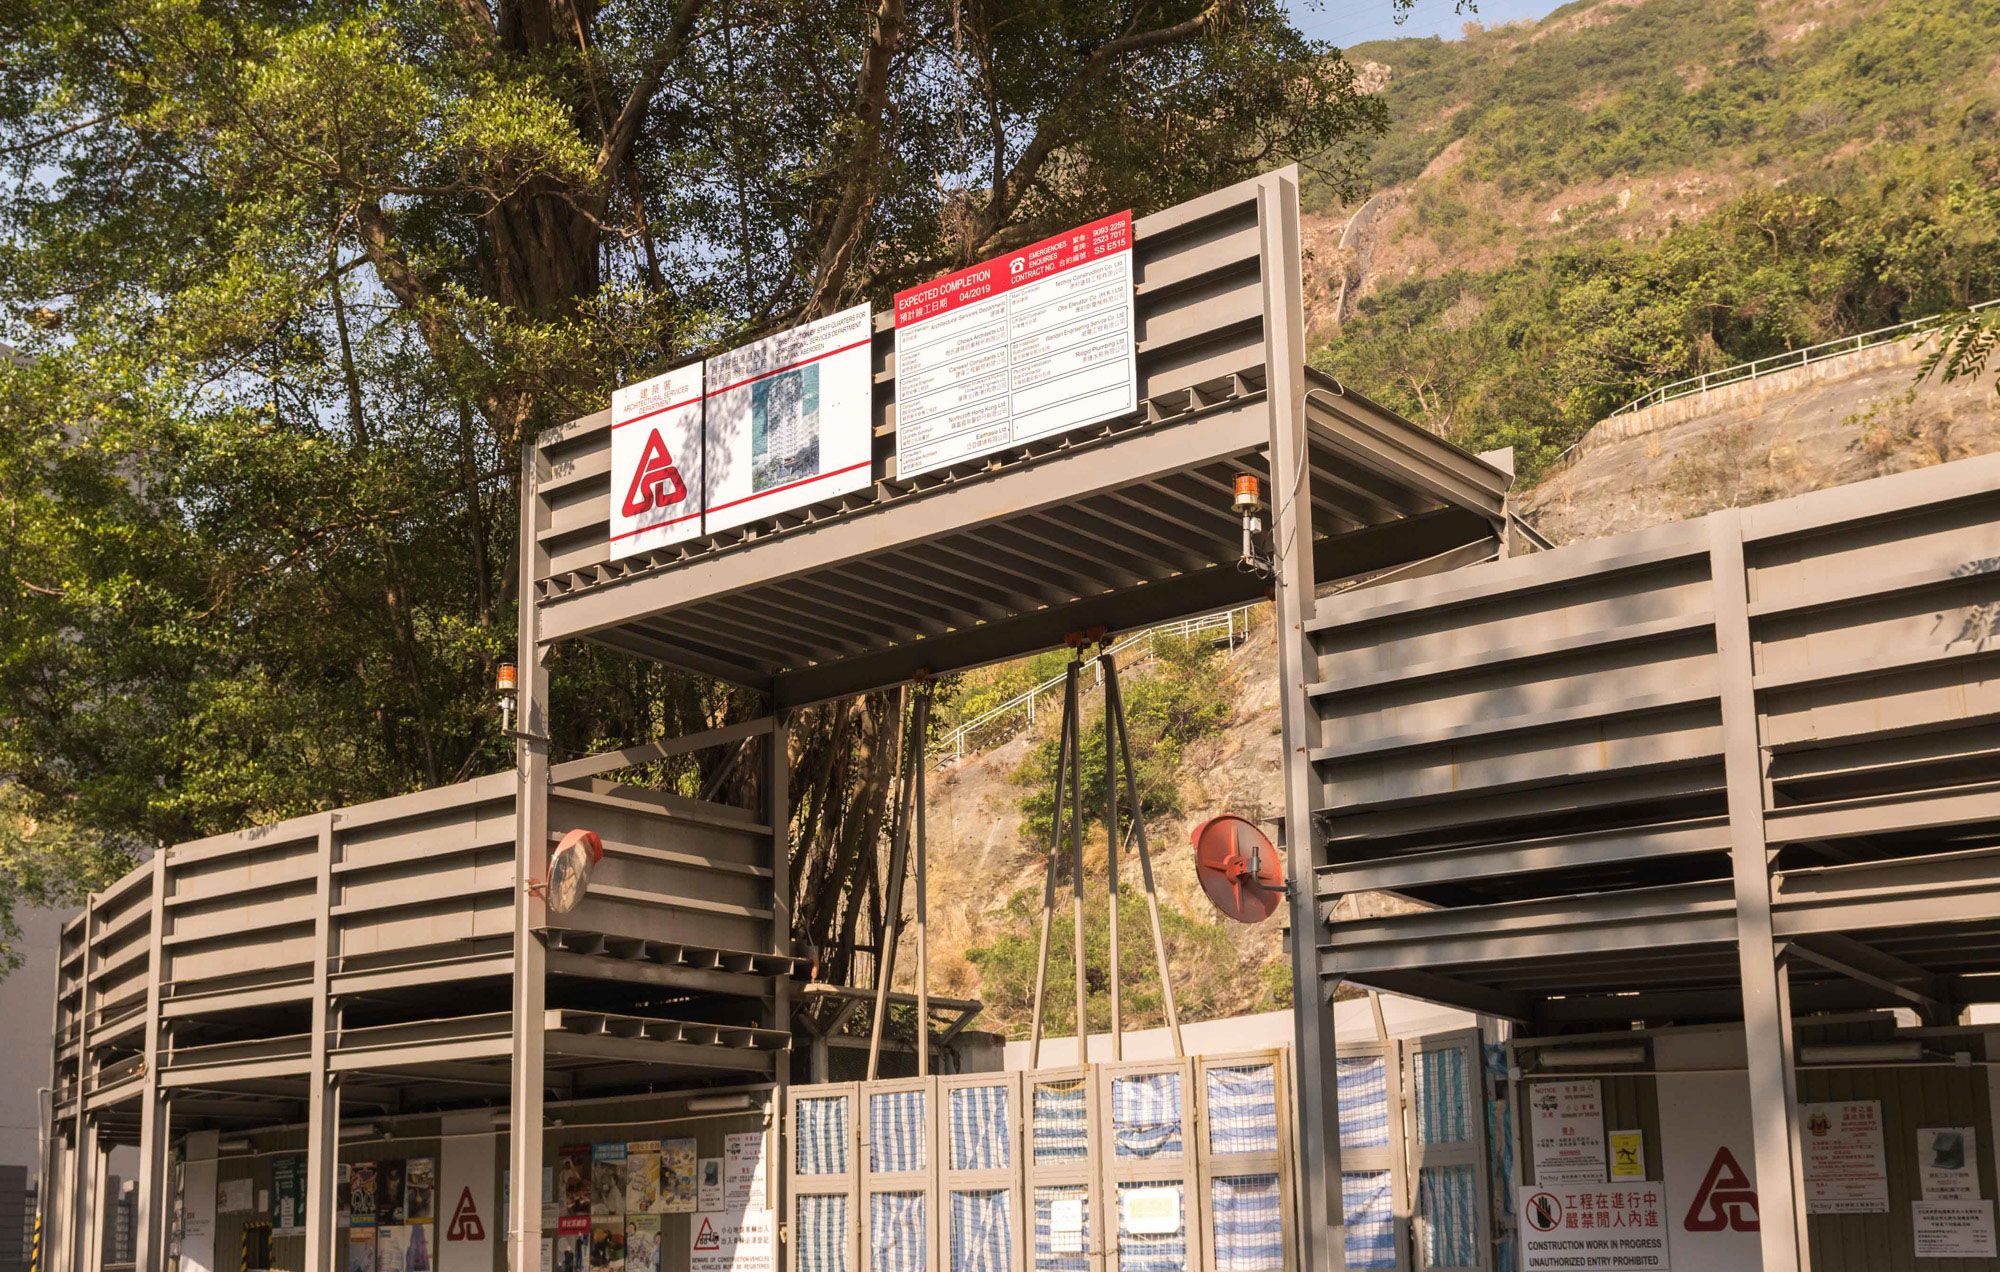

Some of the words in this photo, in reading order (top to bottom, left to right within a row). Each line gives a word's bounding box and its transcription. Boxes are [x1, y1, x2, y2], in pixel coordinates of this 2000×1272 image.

[1093, 226, 1108, 238] 9093
[1093, 235, 1109, 246] 2523
[1110, 229, 1125, 240] 7017
[1029, 241, 1067, 260] EMERGENCIES
[1095, 246, 1105, 255] SS
[1108, 239, 1126, 251] E515
[1029, 253, 1058, 268] ENQUIRIES
[1011, 267, 1044, 285] CONTRACT
[1073, 267, 1103, 282] Construction
[899, 288, 938, 310] EXPECTED
[940, 269, 990, 296] COMPLETION
[960, 284, 990, 302] 04/2019
[1069, 298, 1088, 308] Elevator
[817, 324, 830, 333] STAFF
[832, 315, 855, 329] QUARTERS
[856, 311, 866, 320] FOR
[931, 317, 957, 331] Architectural
[959, 310, 978, 321] Services
[979, 300, 1005, 314] Department
[810, 332, 831, 345] SERVICES
[832, 322, 861, 337] DEPARTMENT
[974, 329, 996, 341] Architects
[1064, 324, 1089, 336] Engineering
[1091, 318, 1107, 327] Service
[801, 343, 825, 356] ABERDEEN
[1092, 341, 1115, 353] Plumbing
[970, 354, 996, 367] Consultants
[624, 394, 662, 412] ARCHITECTURAL
[664, 385, 689, 399] SERVICES
[640, 398, 672, 415] DEPARTMENT
[972, 408, 984, 417] Hong
[985, 404, 997, 412] Kong
[1565, 1192, 1658, 1210] 工程在進行中
[1528, 1240, 1584, 1250] CONSTRUCTION
[1586, 1240, 1609, 1249] WORK
[1610, 1240, 1618, 1249] IN
[1620, 1239, 1662, 1249] PROGRESS
[1530, 1257, 1586, 1267] UNAUTHORIZED
[1588, 1256, 1610, 1266] ENTRY
[1613, 1256, 1658, 1265] PROHIBITED
